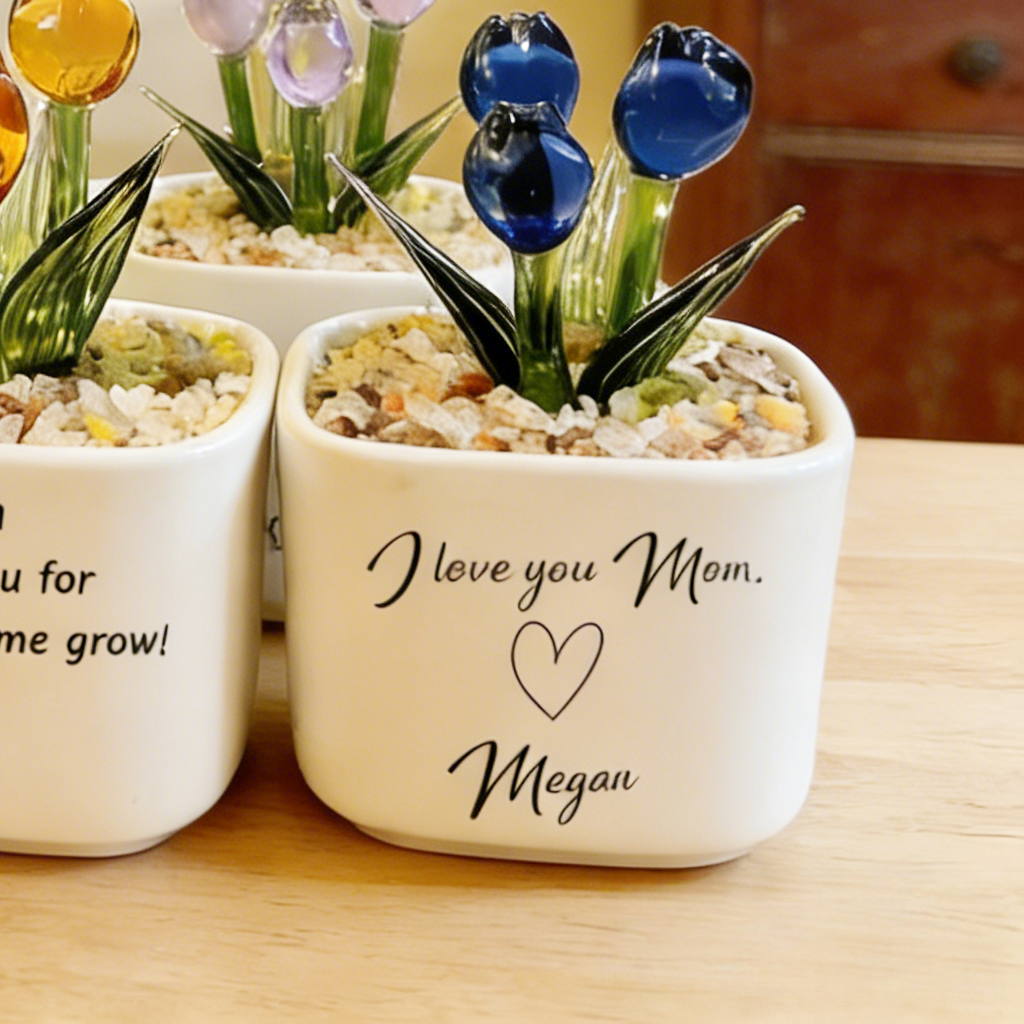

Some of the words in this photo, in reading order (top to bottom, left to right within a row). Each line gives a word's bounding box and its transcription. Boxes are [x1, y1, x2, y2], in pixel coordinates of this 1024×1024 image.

[38, 559, 97, 596] for
[366, 530, 423, 609] I
[433, 541, 511, 583] love
[517, 559, 598, 613] you
[612, 530, 763, 609] Mom.
[65, 623, 169, 667] grow!
[447, 739, 640, 826] Megan
